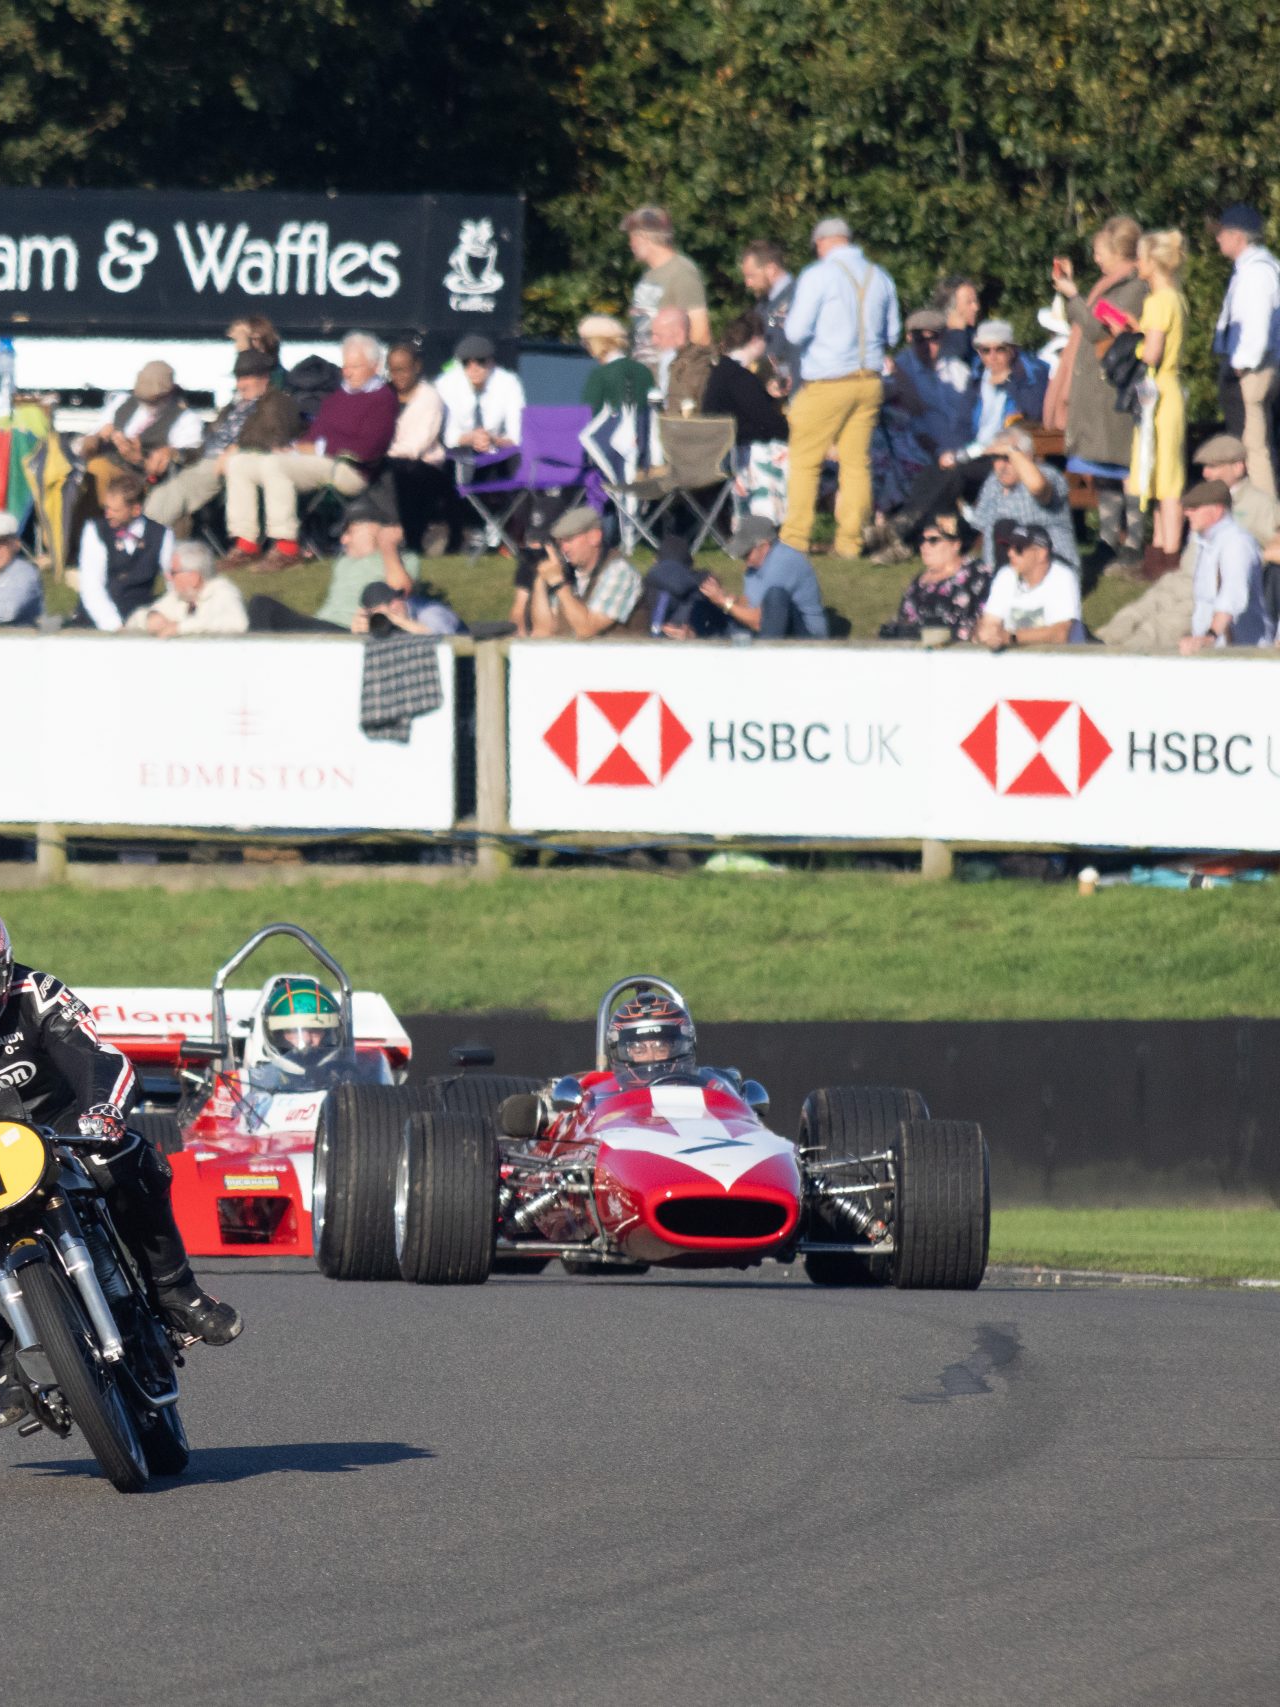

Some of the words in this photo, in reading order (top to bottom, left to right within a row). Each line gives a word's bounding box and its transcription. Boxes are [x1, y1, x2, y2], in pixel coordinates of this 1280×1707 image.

[98, 220, 159, 294] &
[174, 221, 402, 299] Waffles
[707, 720, 832, 765] HSBC
[844, 722, 902, 767] UK
[1128, 729, 1254, 777] HSBC
[140, 761, 357, 791] EDMISTON
[673, 1136, 755, 1155] 7
